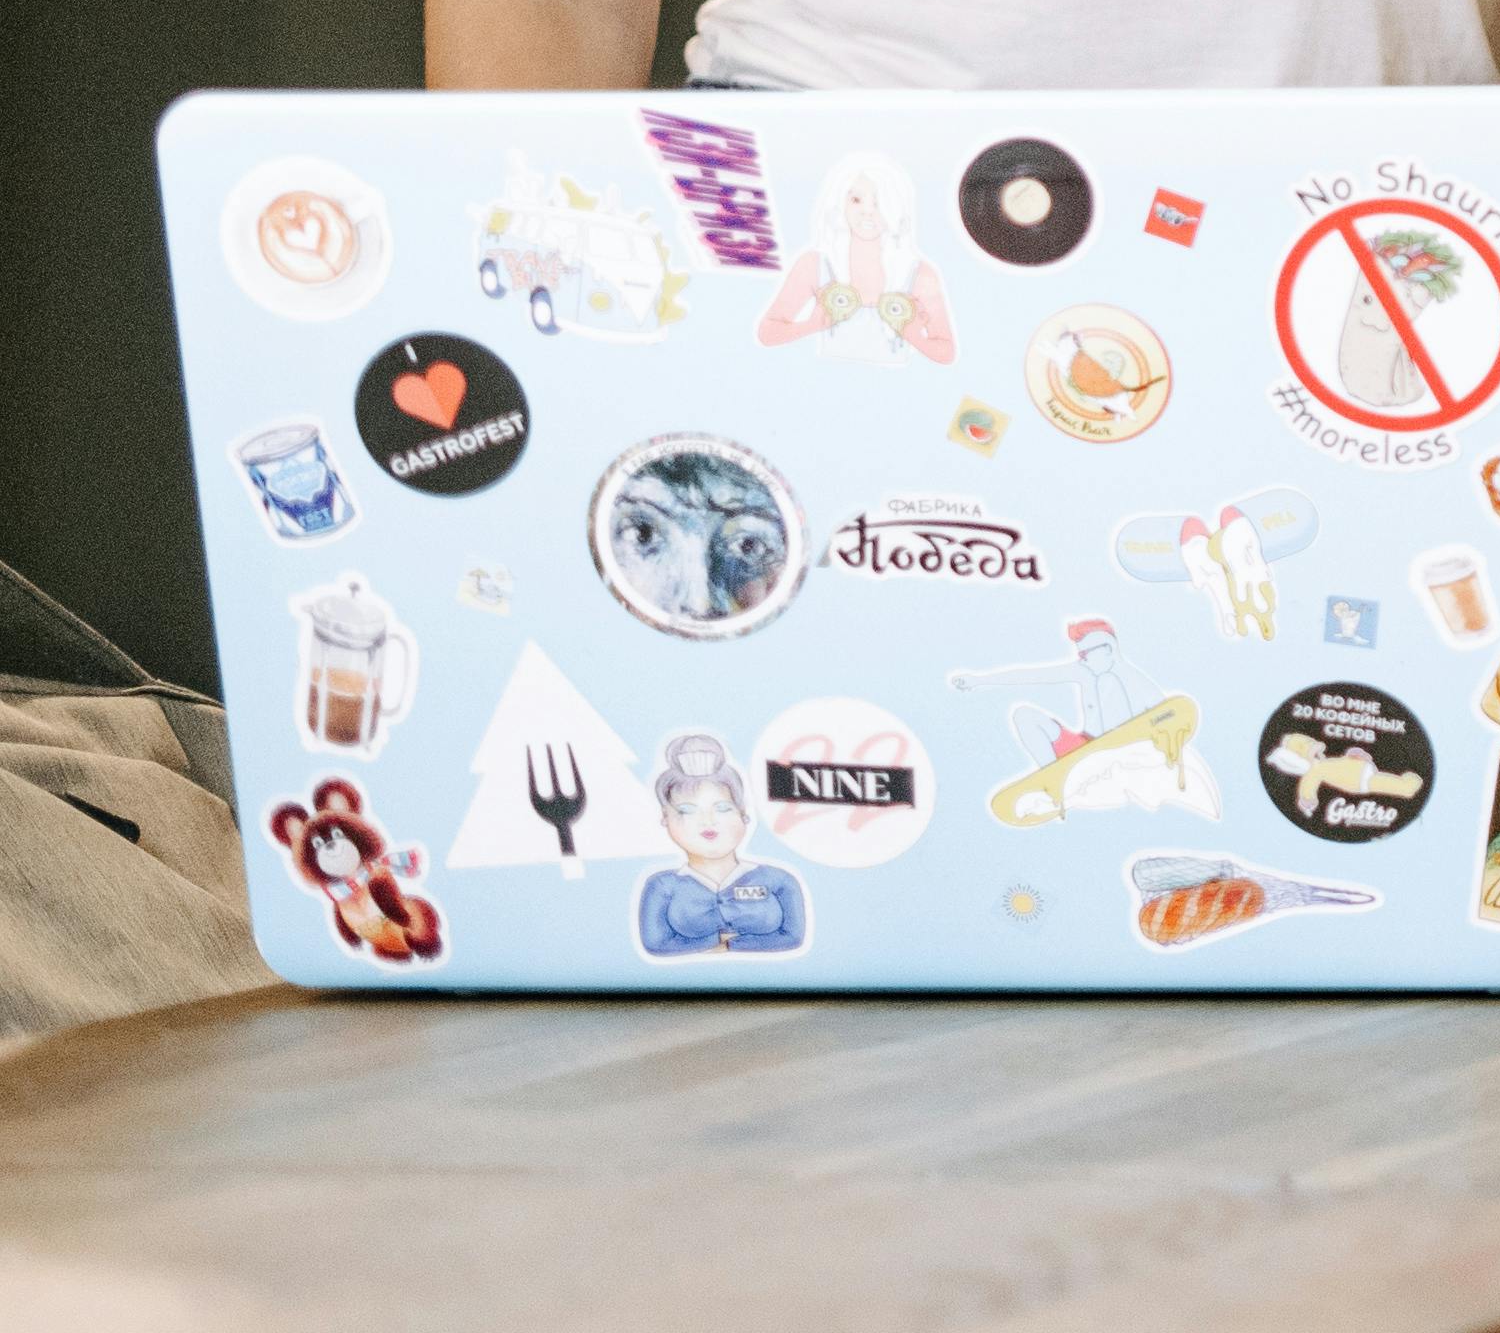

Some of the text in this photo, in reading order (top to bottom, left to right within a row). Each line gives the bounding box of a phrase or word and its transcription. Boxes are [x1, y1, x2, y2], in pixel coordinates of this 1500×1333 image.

[1296, 176, 1354, 217] No
[1273, 384, 1456, 467] #moreless
[389, 412, 526, 479] GASTROFEST
[887, 498, 983, 517] ФАБРИКА
[1320, 693, 1382, 714] ВО МНЕ
[1292, 704, 1407, 734] 20 КОФЕЙНЫХ
[1324, 724, 1377, 744] СЕТОВ
[791, 767, 892, 803] NINE
[1326, 797, 1399, 825] Gastro
